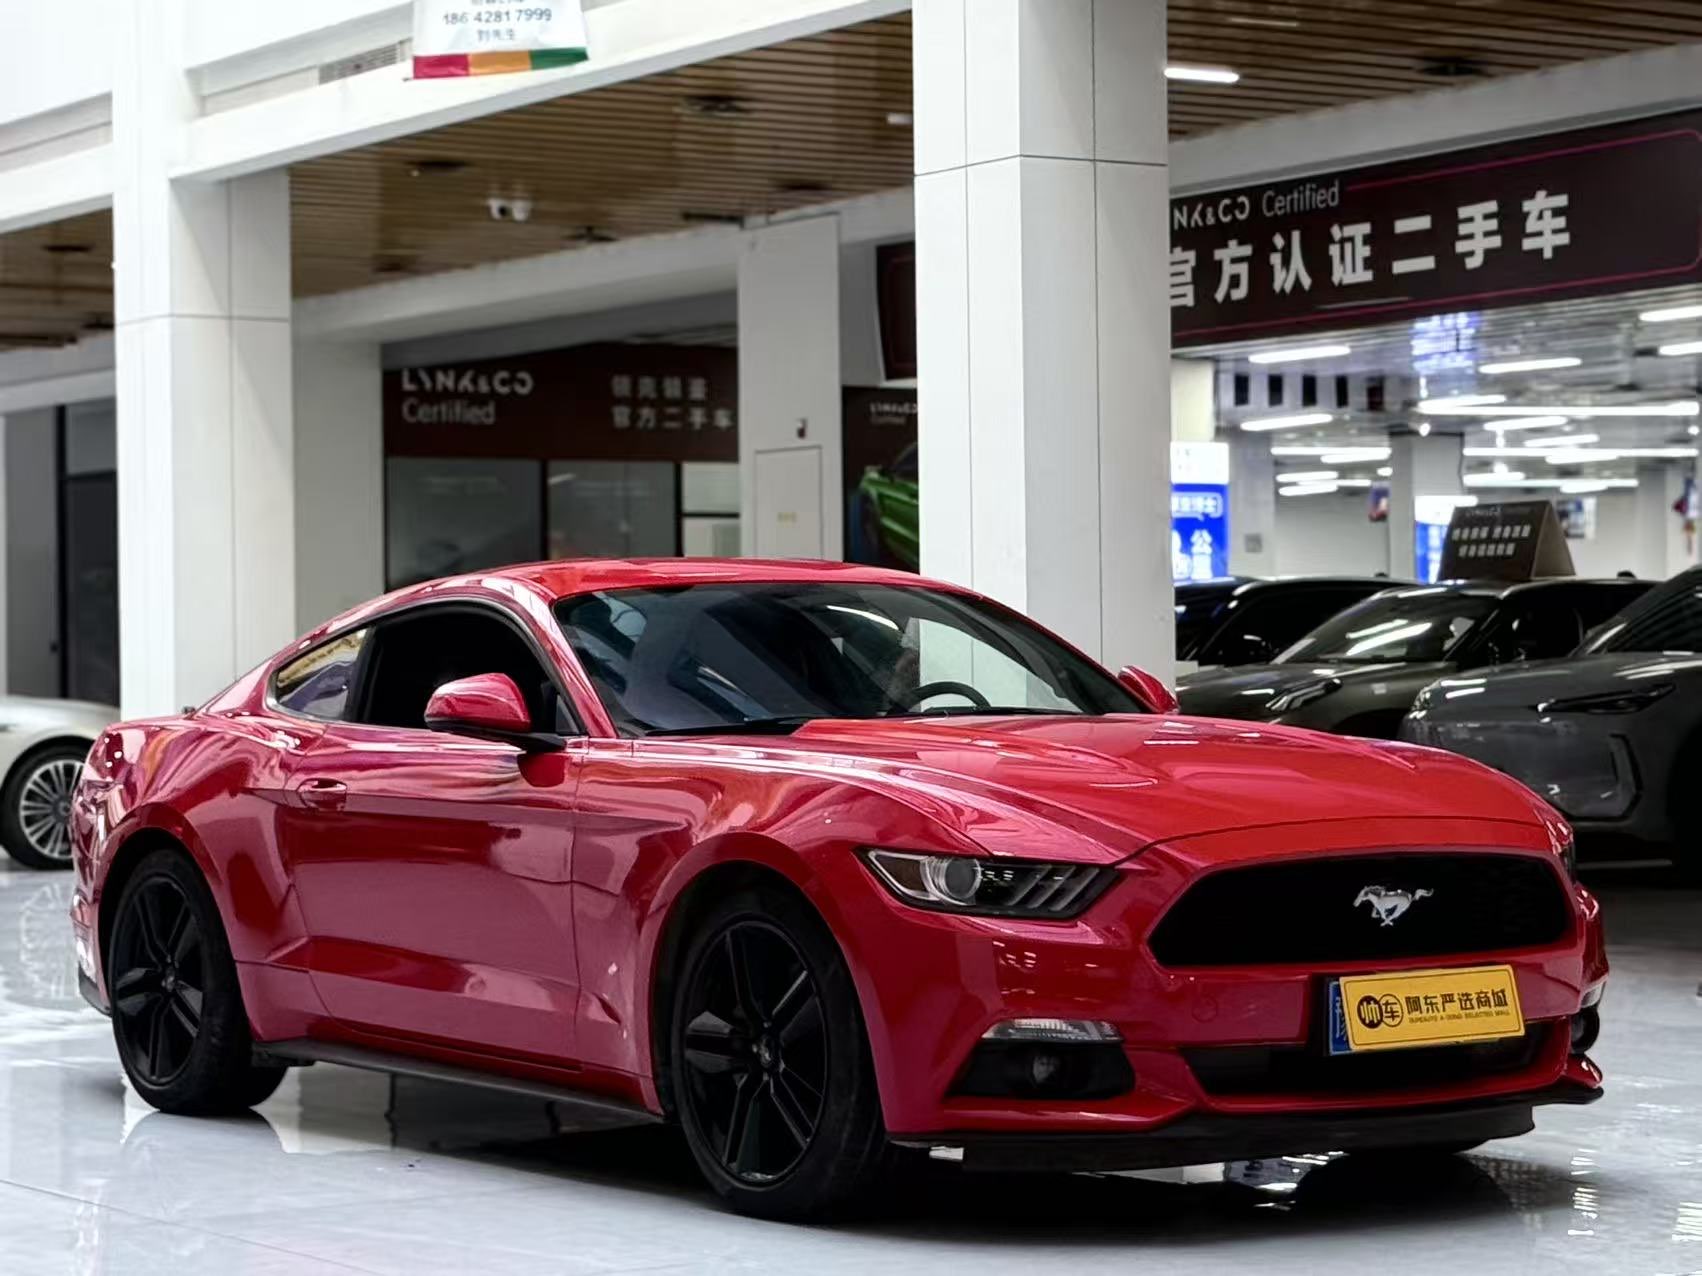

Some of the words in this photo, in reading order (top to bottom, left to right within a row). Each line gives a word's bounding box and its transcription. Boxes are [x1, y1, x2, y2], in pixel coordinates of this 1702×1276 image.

[473, 10, 511, 23] 4281
[515, 8, 553, 22] 7999
[1262, 179, 1341, 218] Certified
[1170, 189, 1571, 308] 官方认证二手车
[401, 396, 496, 425] Certified
[1404, 988, 1509, 1015] 阿东严选商城
